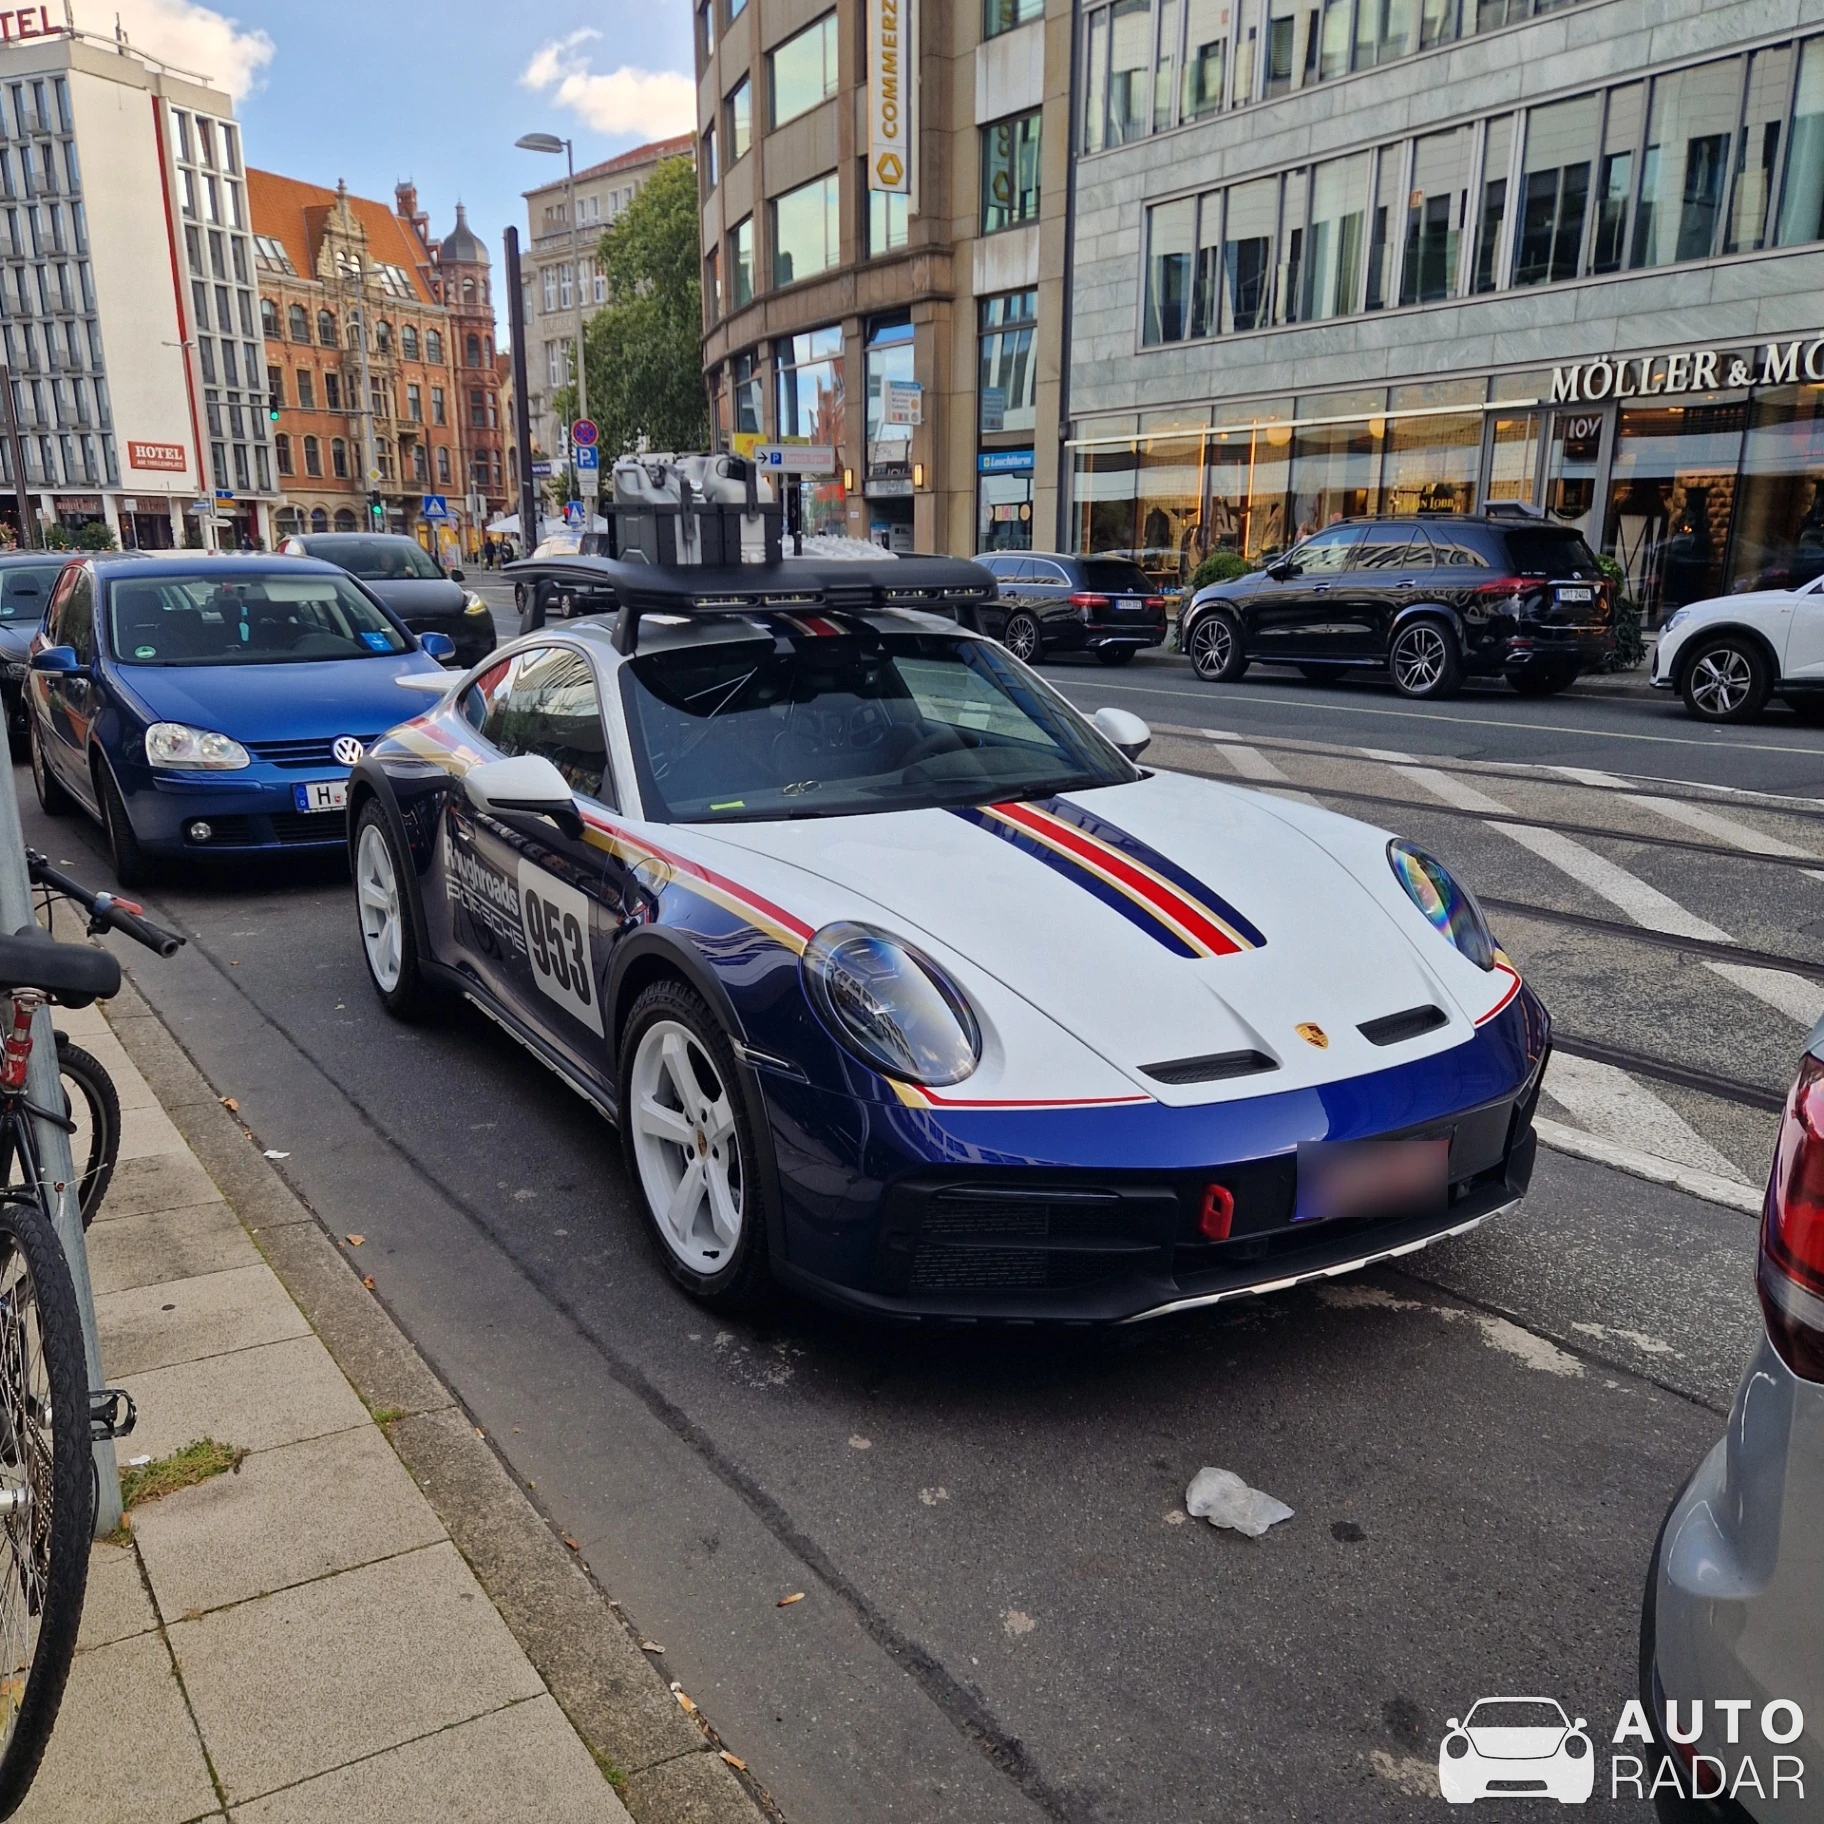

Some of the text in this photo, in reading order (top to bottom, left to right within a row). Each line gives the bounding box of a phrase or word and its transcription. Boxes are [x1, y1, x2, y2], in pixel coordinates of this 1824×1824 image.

[882, 0, 898, 138] COMMERZ
[1548, 352, 1720, 403] MÖLLER
[1728, 359, 1757, 387] &
[135, 445, 183, 460] HOTEL
[579, 448, 592, 466] P
[772, 454, 780, 464] P
[317, 786, 331, 805] H
[443, 833, 520, 917] Roughroads
[446, 881, 528, 955] PORSCHE
[525, 888, 592, 1006] 953
